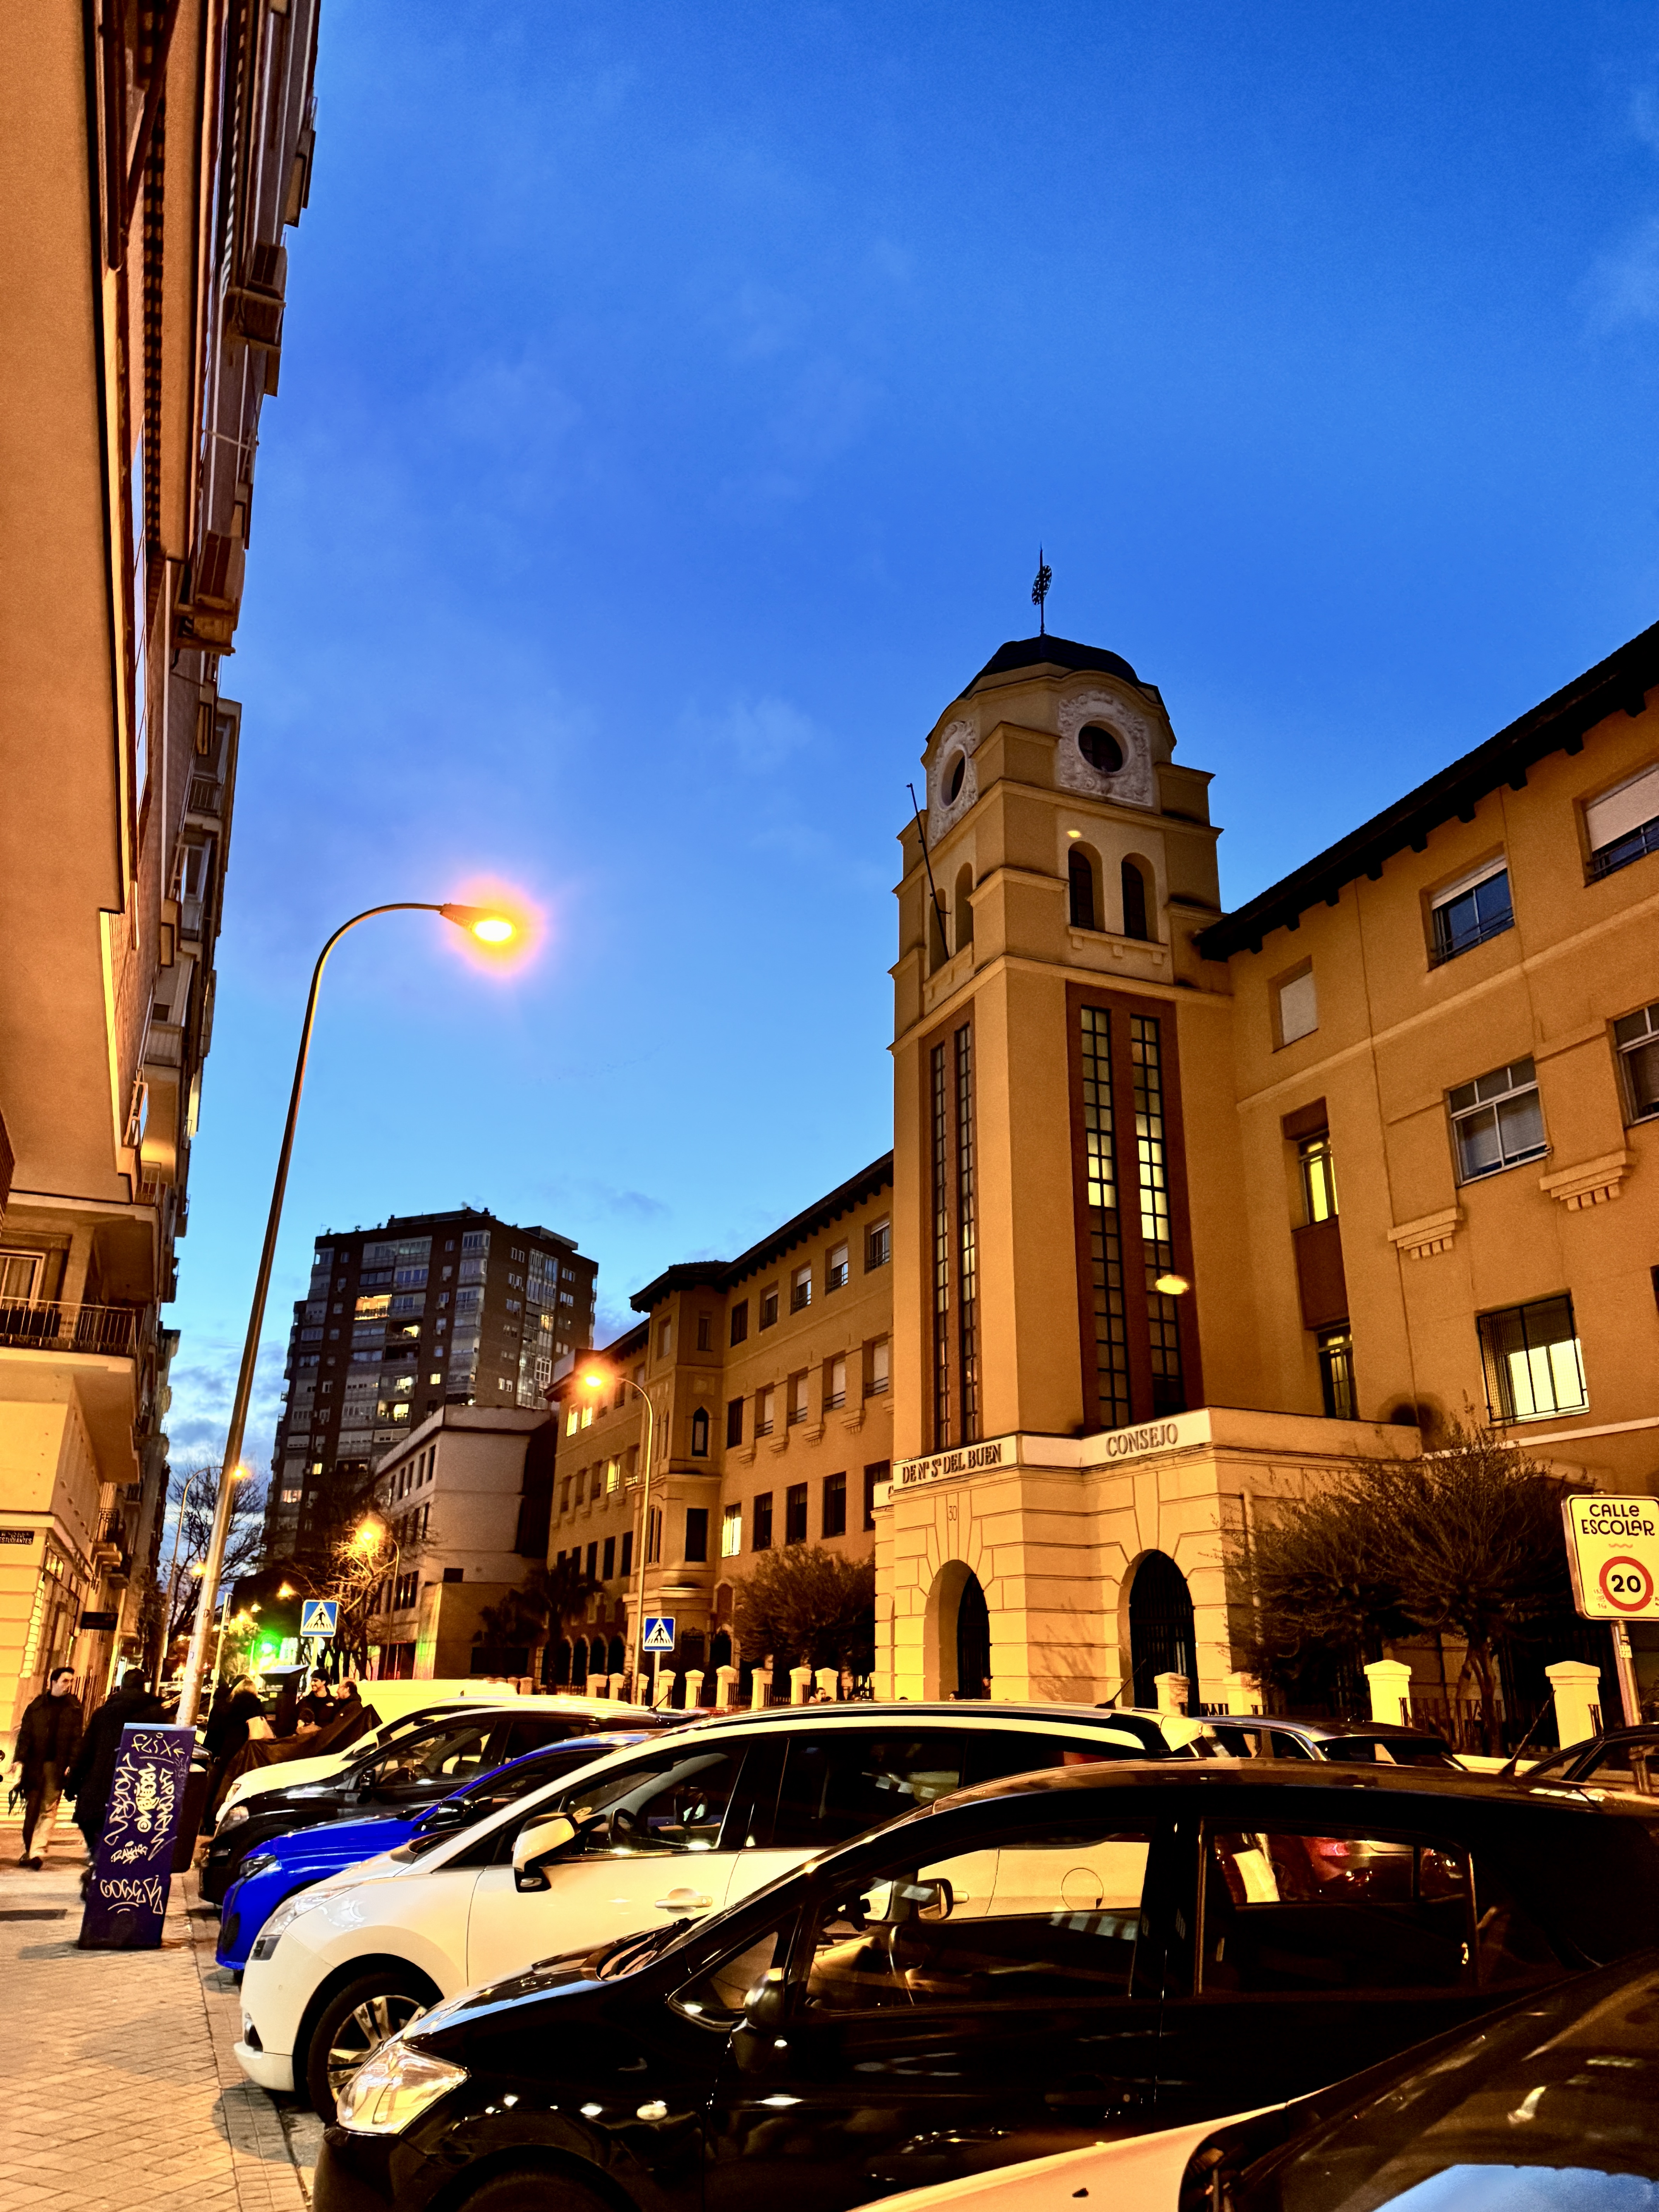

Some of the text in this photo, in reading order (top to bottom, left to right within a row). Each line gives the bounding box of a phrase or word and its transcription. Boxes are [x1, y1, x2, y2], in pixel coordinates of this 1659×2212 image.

[1106, 1423, 1178, 1457] CONSEJO
[902, 1464, 917, 1484] DE
[943, 1452, 965, 1474] DEL
[967, 1443, 1001, 1468] BUEN
[948, 1506, 957, 1521] 30
[1581, 1519, 1655, 1536] ESCOLAR
[1611, 1575, 1641, 1592] 20
